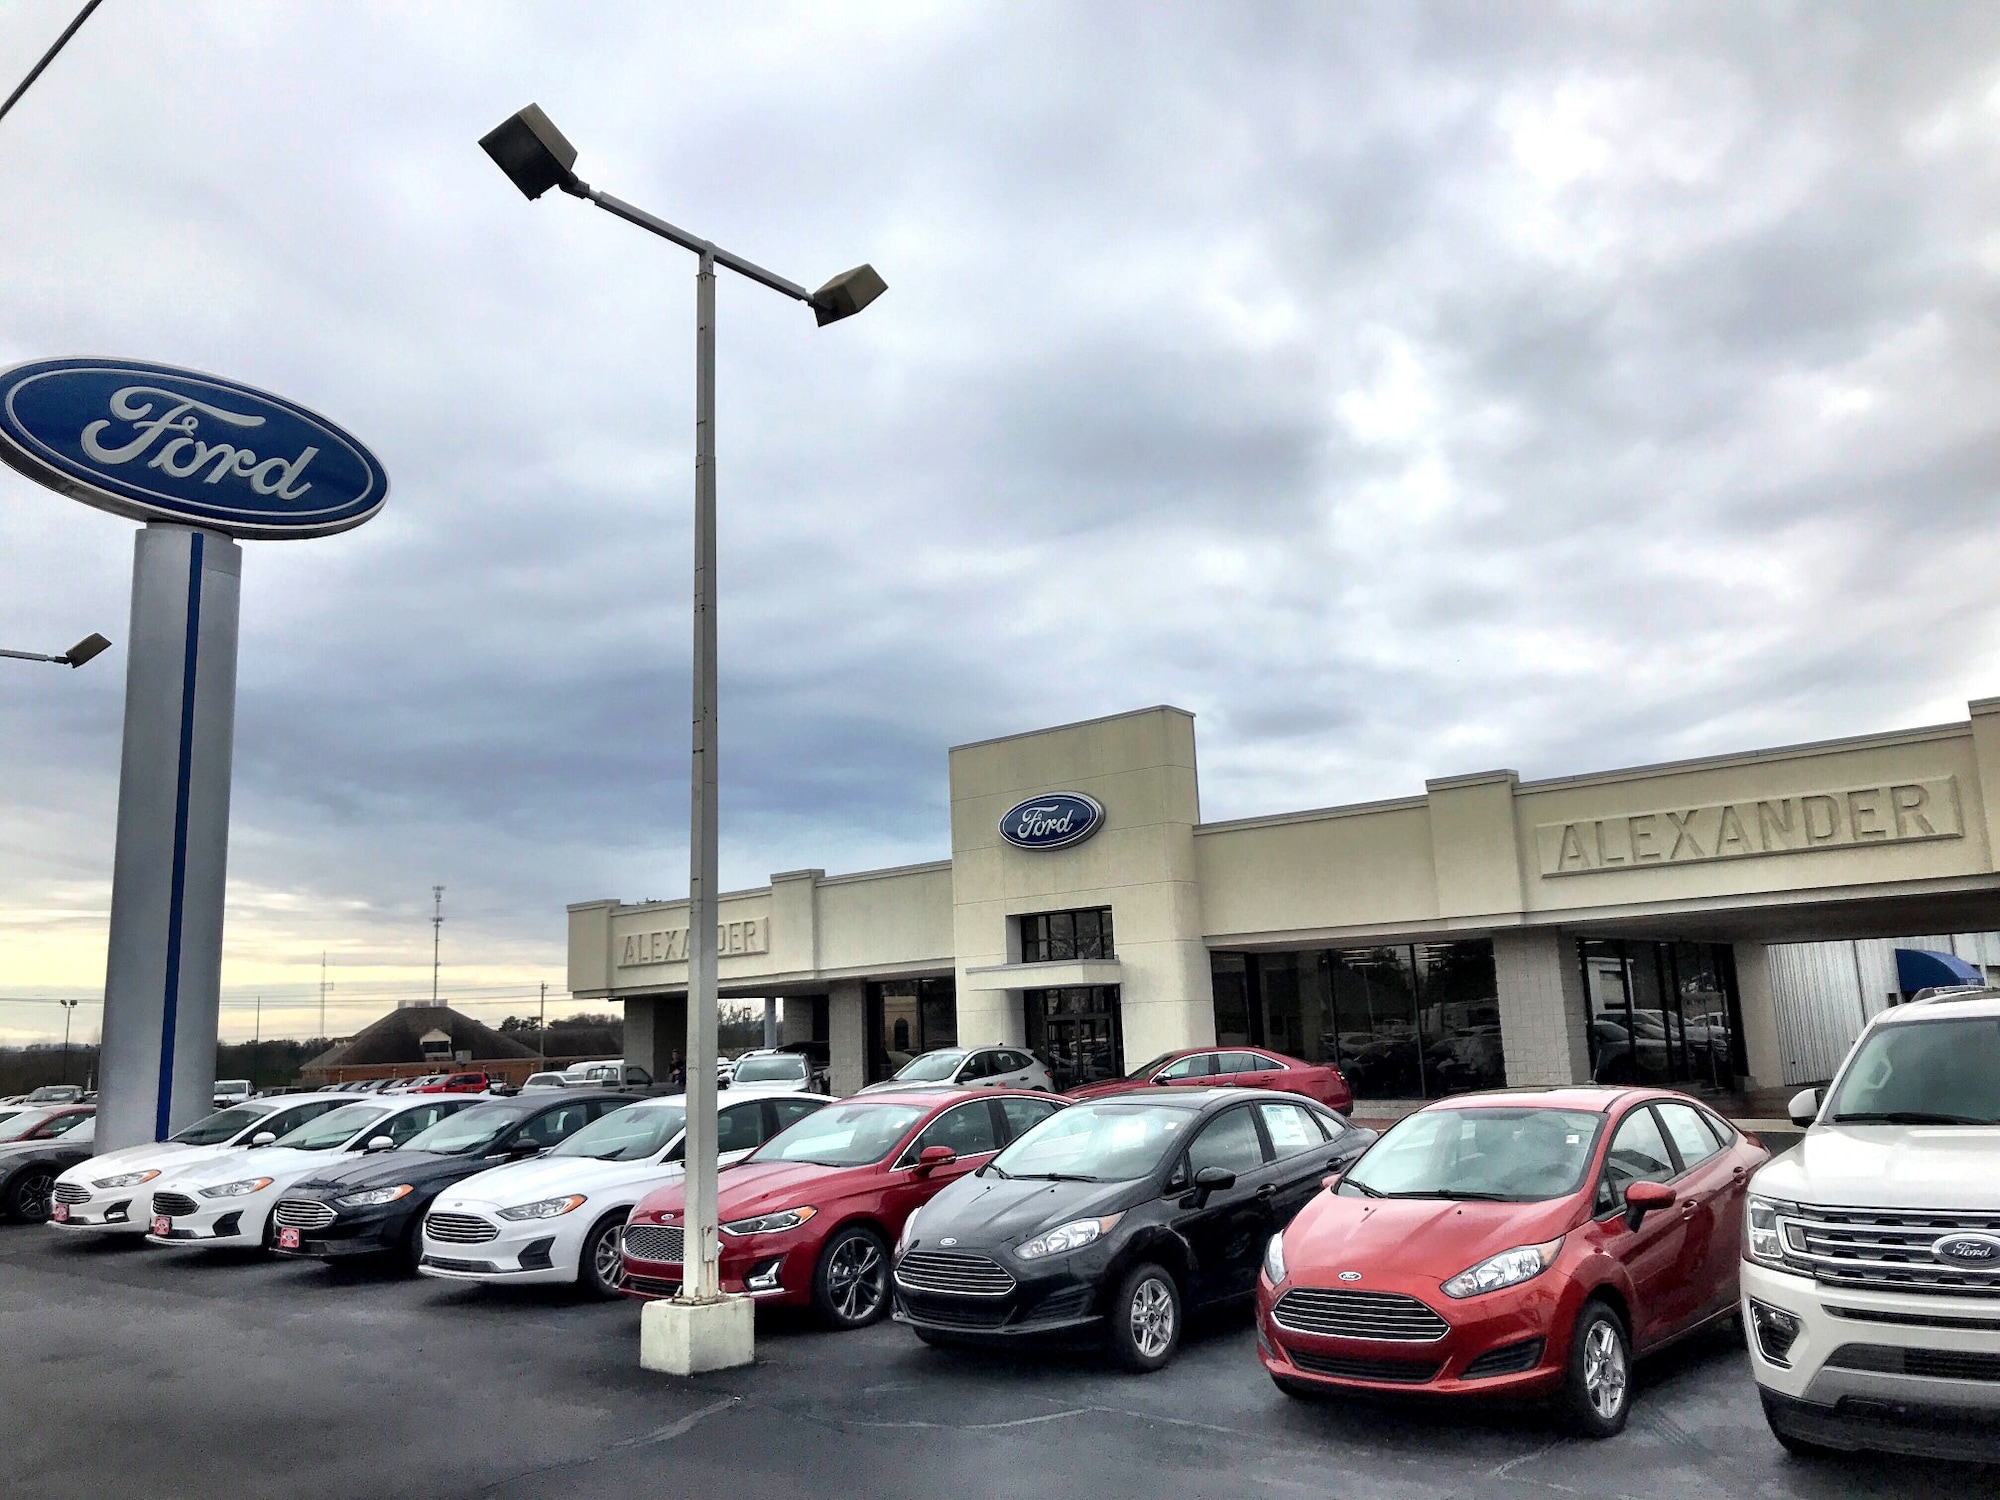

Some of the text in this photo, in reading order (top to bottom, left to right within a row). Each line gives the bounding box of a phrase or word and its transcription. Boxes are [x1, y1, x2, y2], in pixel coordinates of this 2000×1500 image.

[81, 386, 320, 500] Ford
[1017, 804, 1074, 838] Ford
[1558, 784, 1936, 871] ALEXANDER
[623, 921, 757, 964] ALEXADER
[1952, 1242, 1991, 1257] Ford
